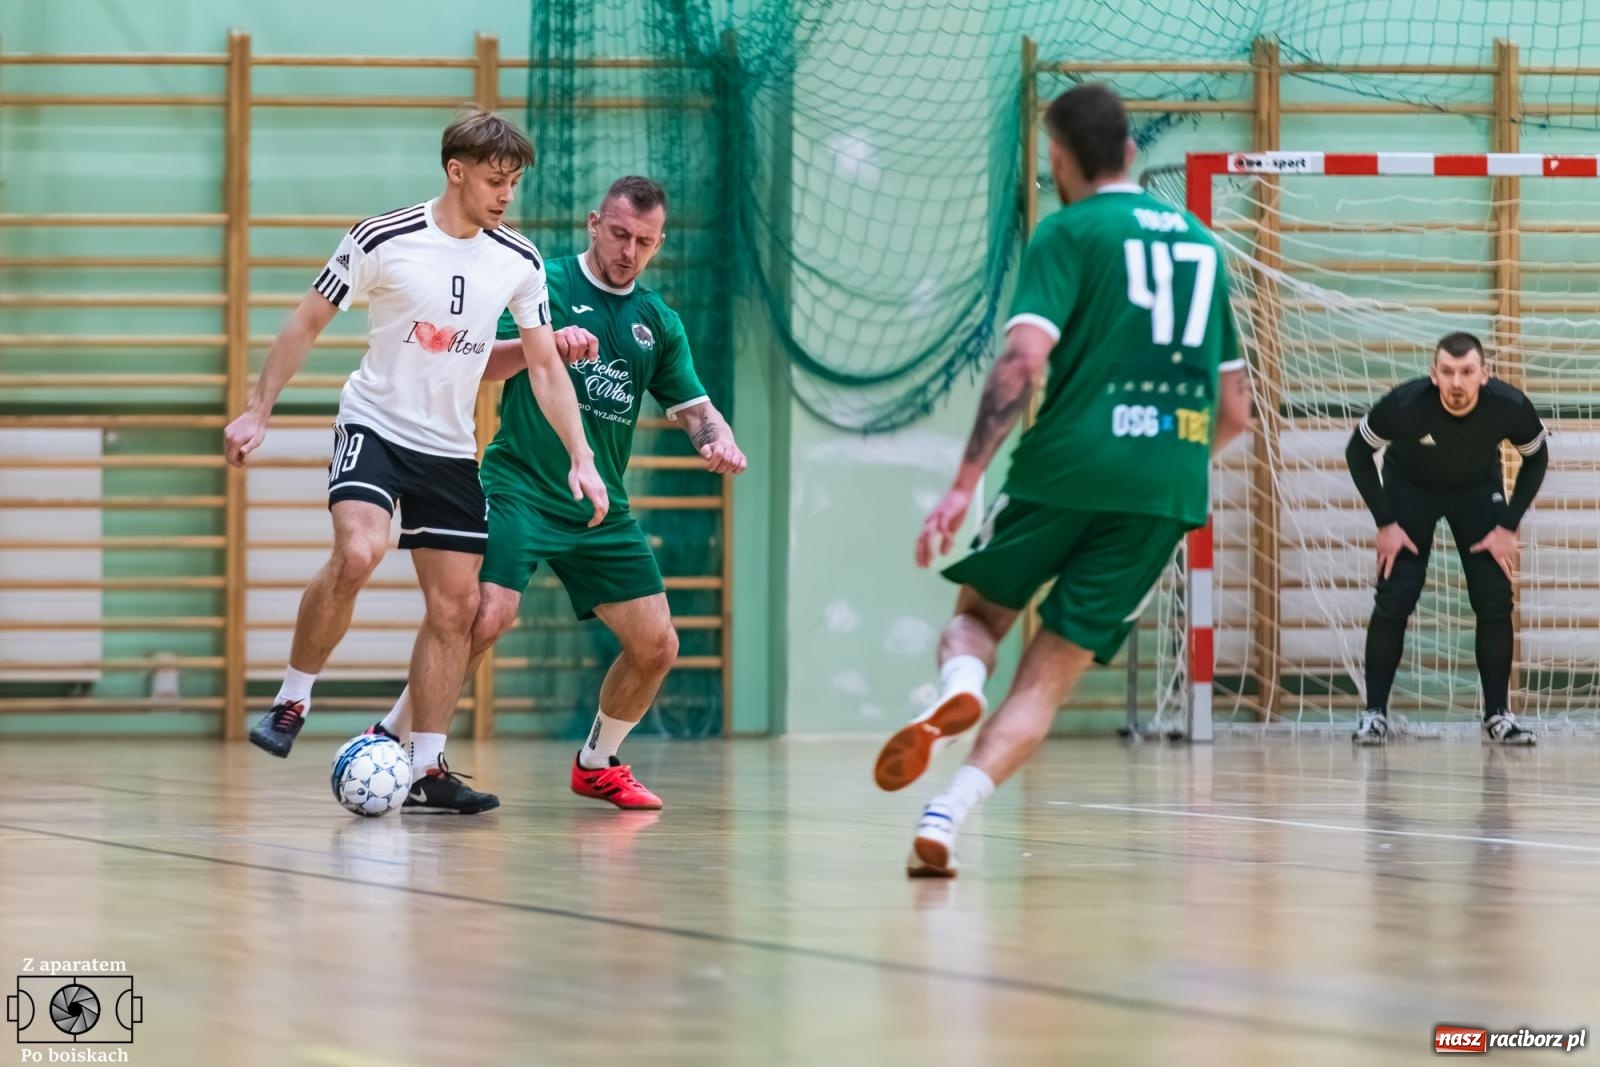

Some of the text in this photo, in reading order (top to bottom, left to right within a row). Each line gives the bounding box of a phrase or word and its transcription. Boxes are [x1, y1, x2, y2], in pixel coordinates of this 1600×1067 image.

[450, 275, 464, 315] 9
[1124, 239, 1217, 347] 47
[402, 320, 422, 343] I
[1112, 404, 1159, 438] OSG
[342, 433, 365, 472] 9
